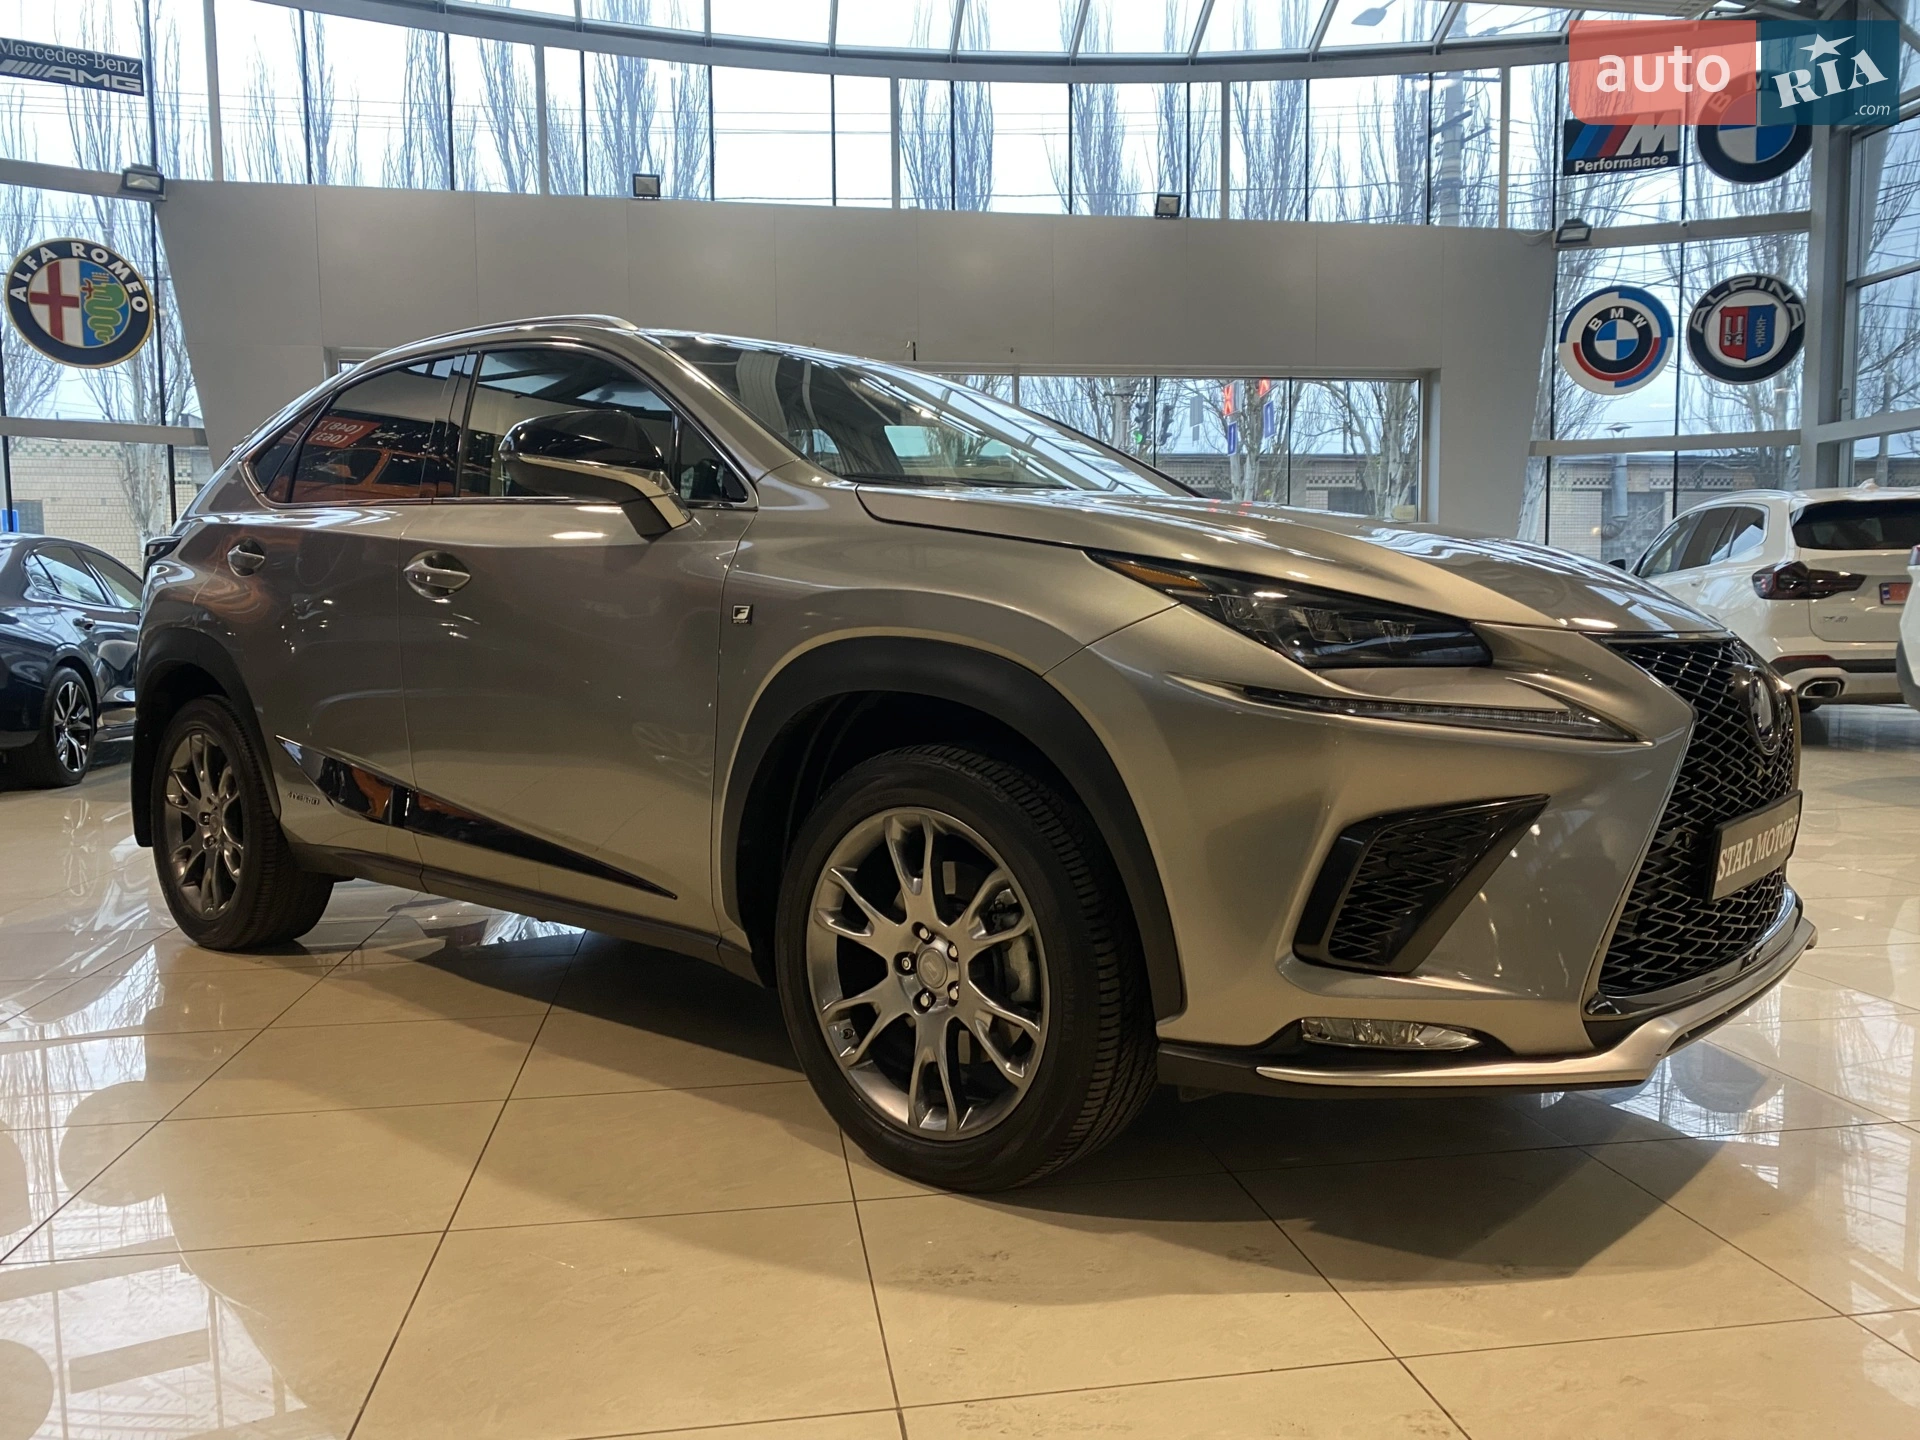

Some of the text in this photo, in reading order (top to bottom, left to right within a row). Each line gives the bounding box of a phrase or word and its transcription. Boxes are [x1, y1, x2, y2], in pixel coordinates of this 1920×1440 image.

[0, 39, 139, 75] Mercedes-Benz
[1574, 154, 1669, 172] Performance
[9, 242, 149, 313] ALFA ROMEO
[1588, 307, 1648, 331] BMW
[1692, 276, 1805, 334] ALPINA
[1717, 838, 1754, 882] STAR
